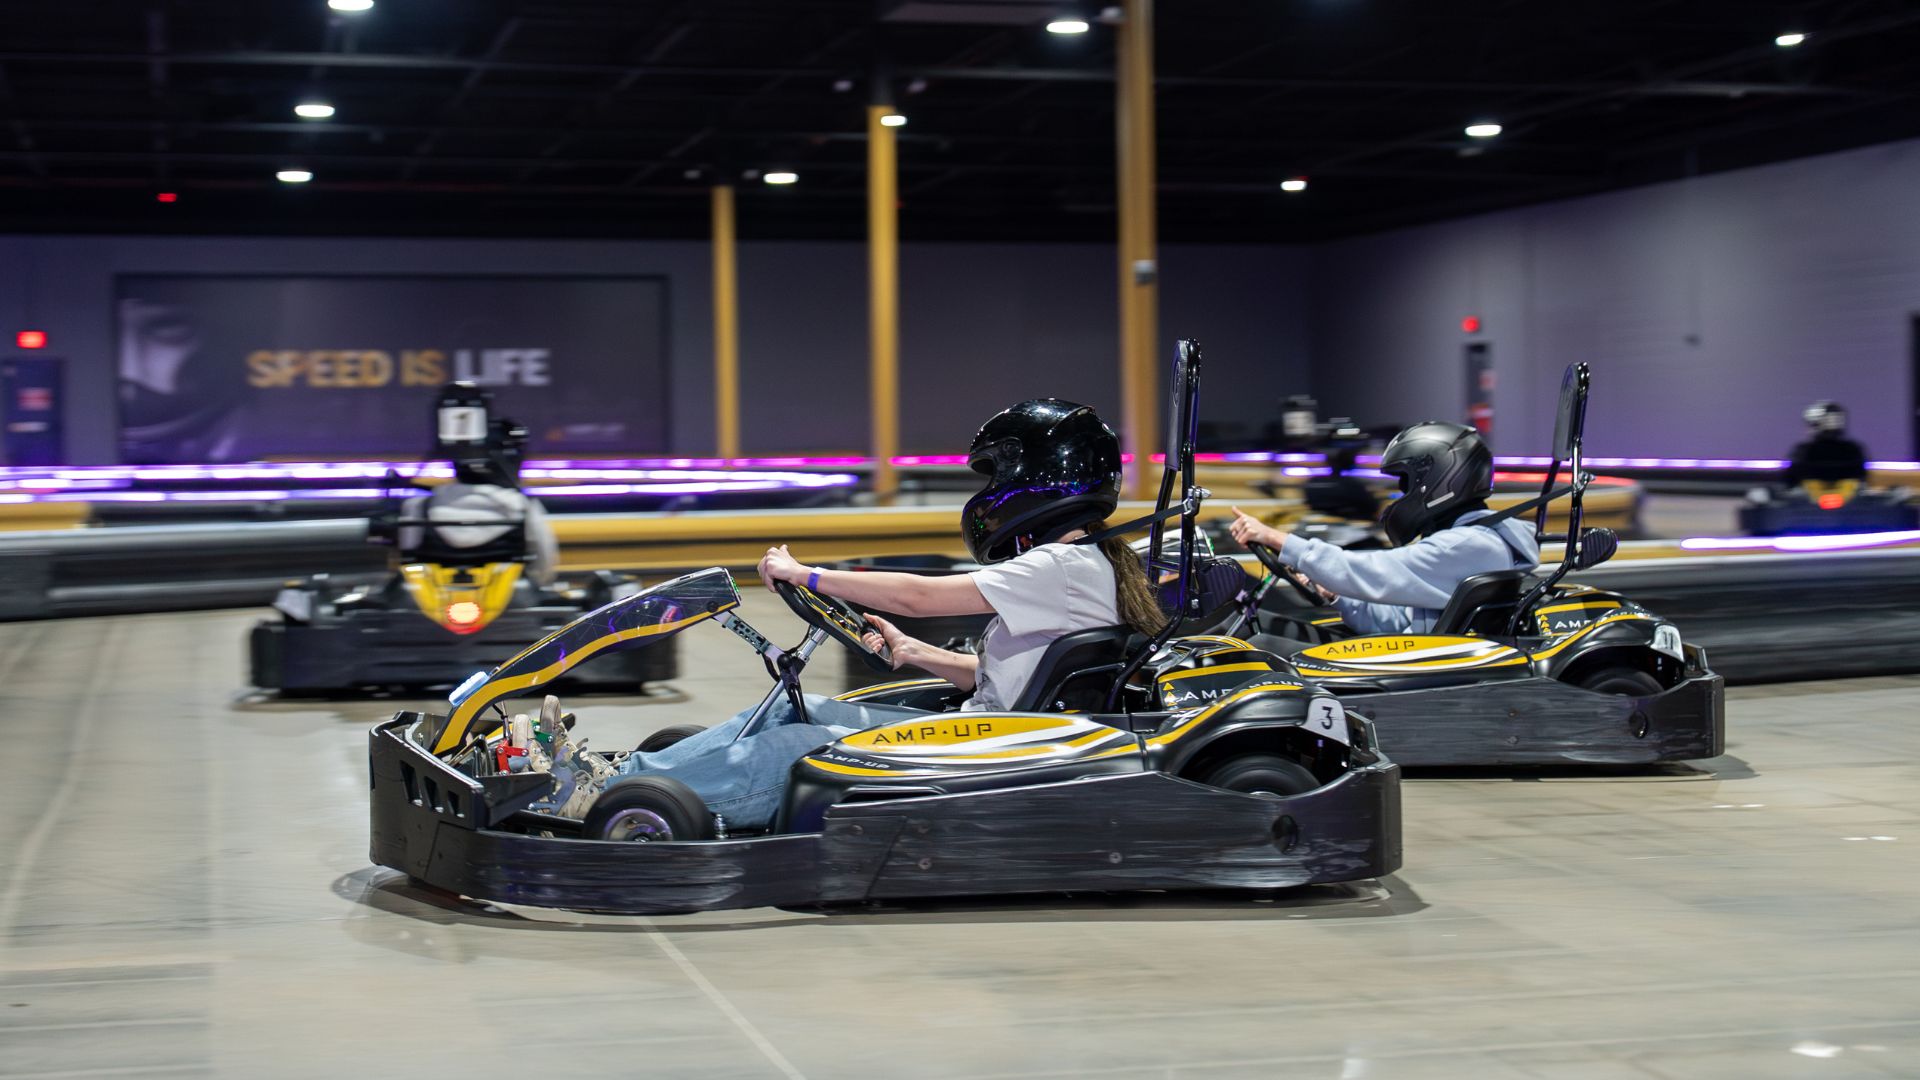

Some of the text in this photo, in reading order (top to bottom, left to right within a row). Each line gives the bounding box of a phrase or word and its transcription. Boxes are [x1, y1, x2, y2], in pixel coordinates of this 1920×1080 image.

[247, 350, 549, 387] SPEED IS LIFE
[1321, 705, 1333, 730] 3
